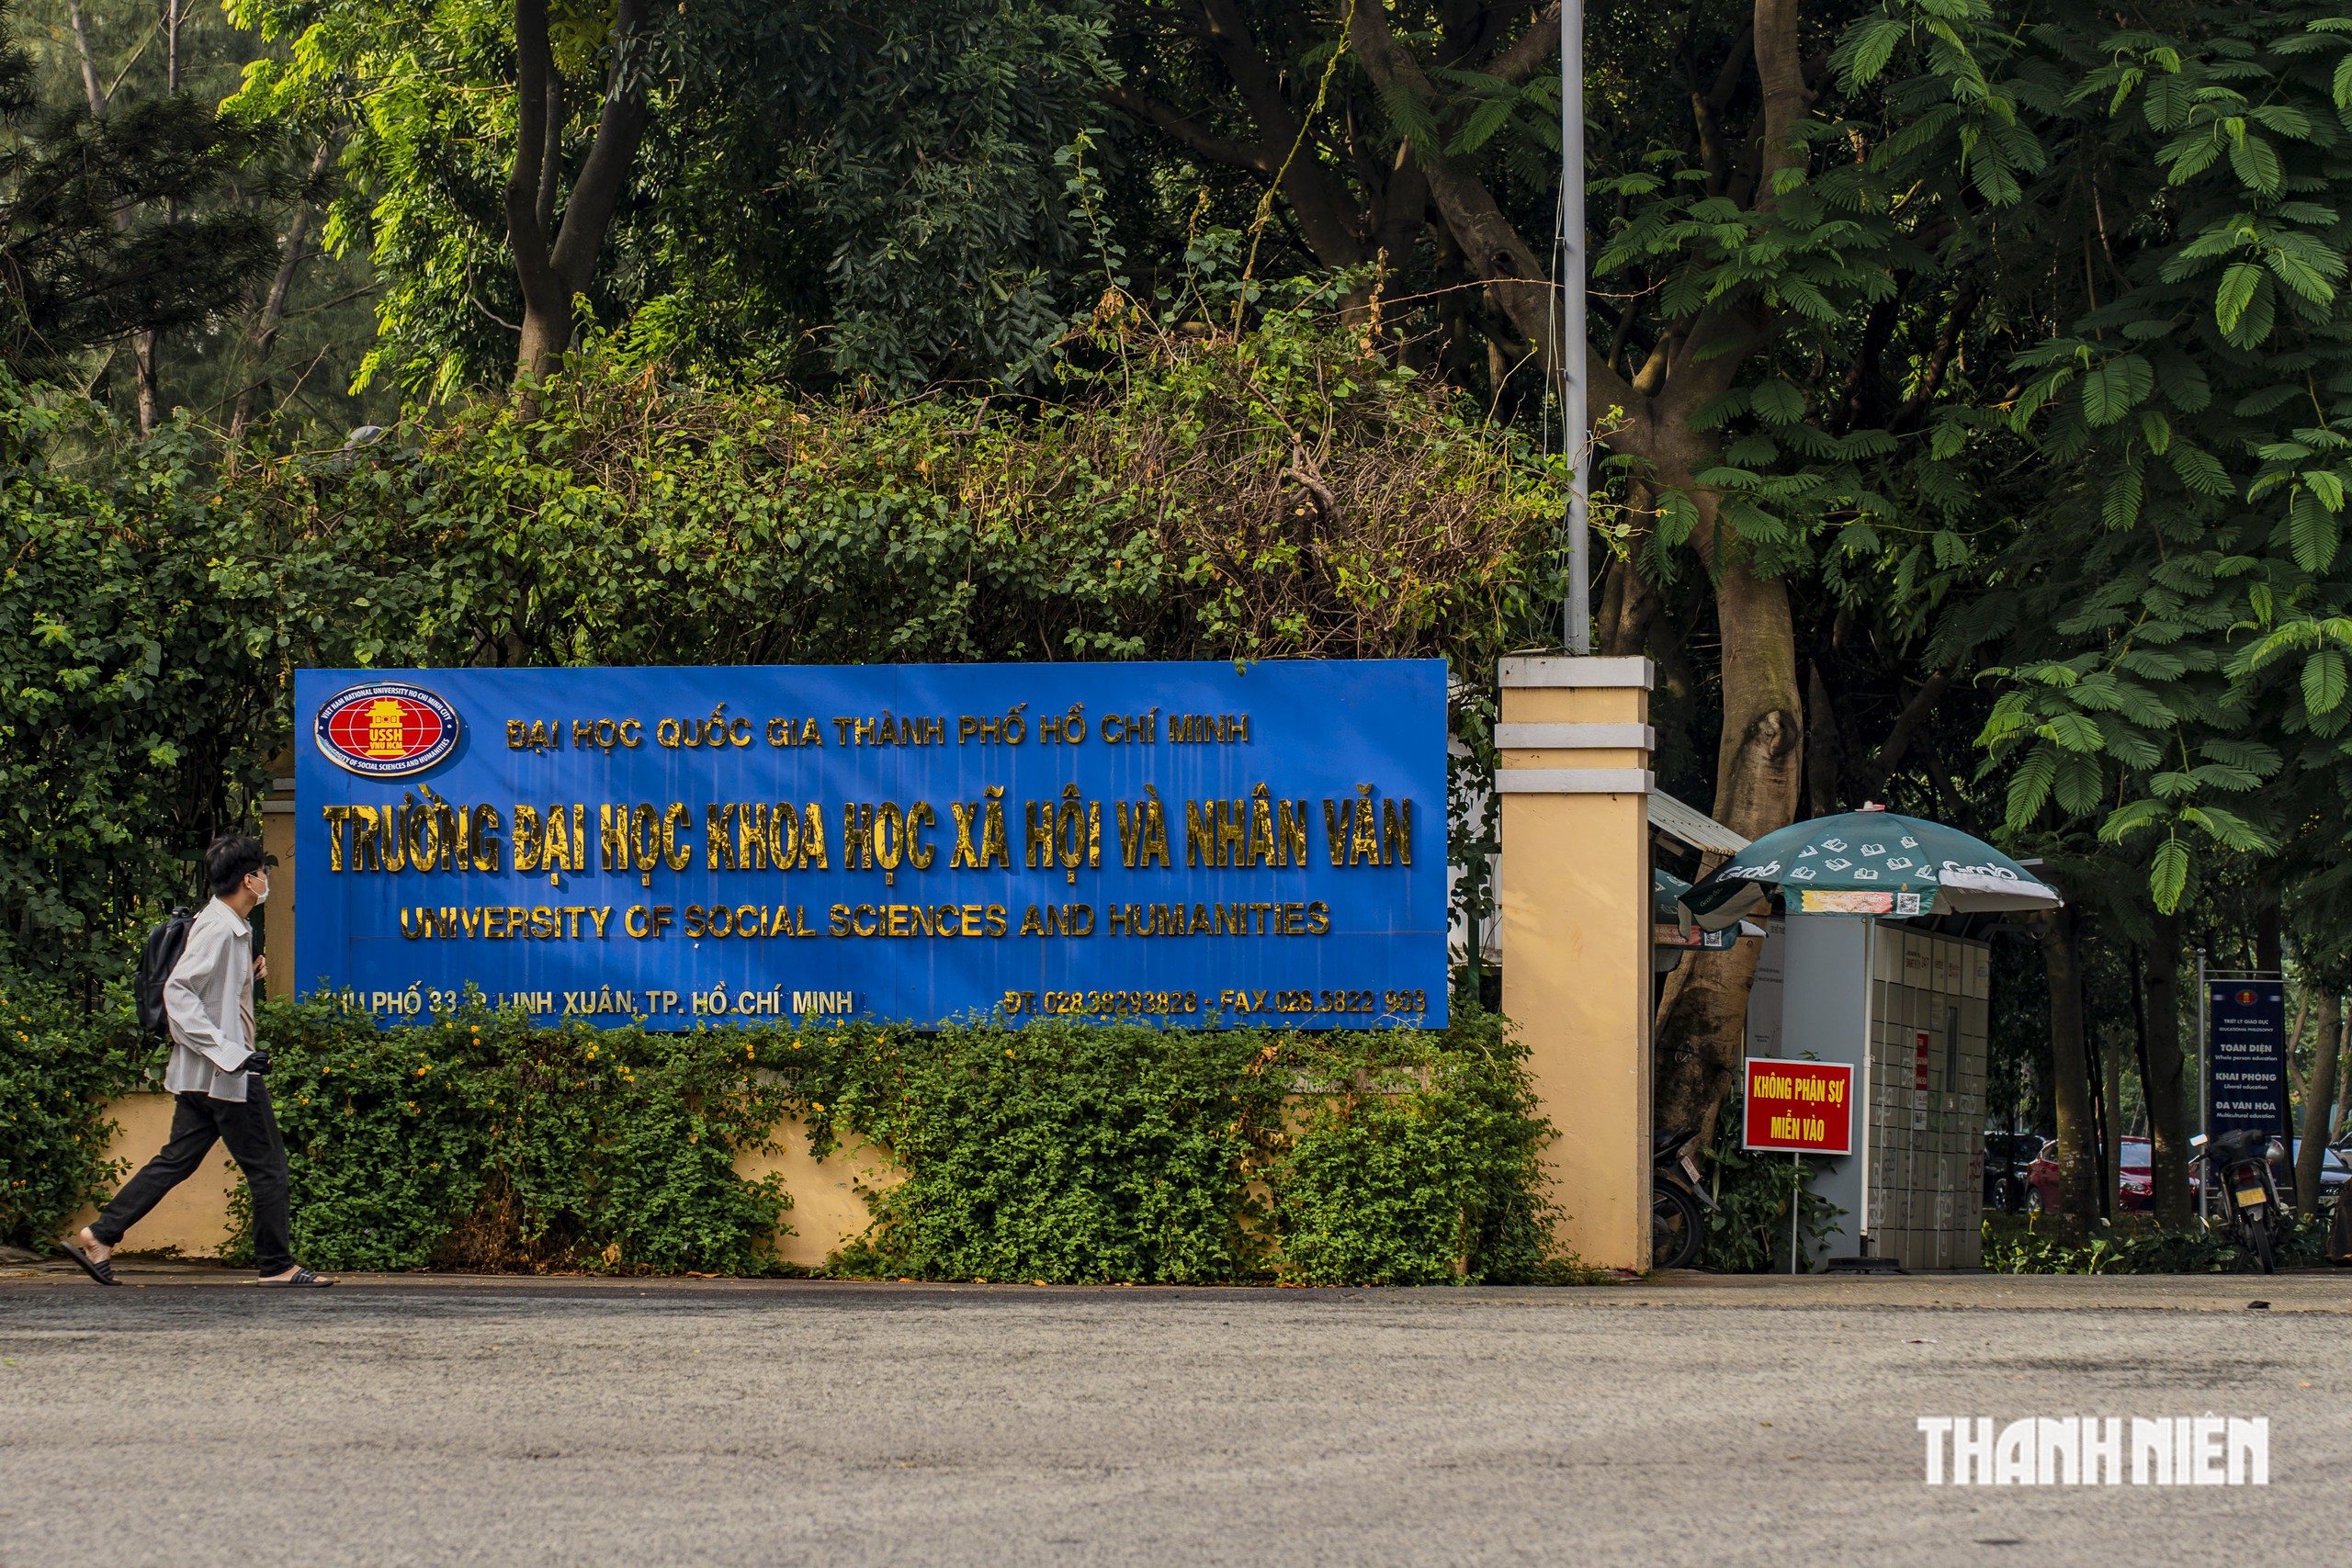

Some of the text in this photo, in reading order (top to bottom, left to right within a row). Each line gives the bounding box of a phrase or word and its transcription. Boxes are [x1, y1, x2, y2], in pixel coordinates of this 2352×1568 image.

[321, 686, 453, 721] VIET NAM NATIONAL UNIVERSITY HO CHI MINH CITY
[369, 728, 403, 742] USSH
[505, 702, 1249, 754] ĐẠI HỌC QUỐC GIA THÀNH PHỐ HỒ CHÍ MINH
[349, 758, 358, 766] OF
[357, 761, 379, 771] SOCIAL
[379, 762, 406, 771] SCIENCES
[406, 758, 420, 768] AND
[419, 738, 450, 764] HUMANITIES
[322, 782, 1412, 886] TRƯỜNG ĐẠI HỌC KHOA HỌC XÃ HỘI VÀ NHÂN VĂN
[1715, 860, 1781, 884] Grab
[400, 901, 1330, 940] UNIVERSITY OF SOCIAL SCIENCES AND HUMANITIES
[372, 980, 422, 1014] PHỐ
[428, 991, 457, 1014] 33
[645, 990, 684, 1014] TP.
[692, 980, 727, 1014] HỒ
[738, 983, 782, 1014] CHÍ
[792, 990, 853, 1014] MINH
[2249, 1043, 2273, 1054] DIỆN
[1753, 1071, 1845, 1108] KHÔNG PHẬN SỰ
[2215, 1072, 2240, 1081] KHAI
[2215, 1101, 2231, 1110] ĐA
[1770, 1109, 1825, 1142] MIỄN VÀO
